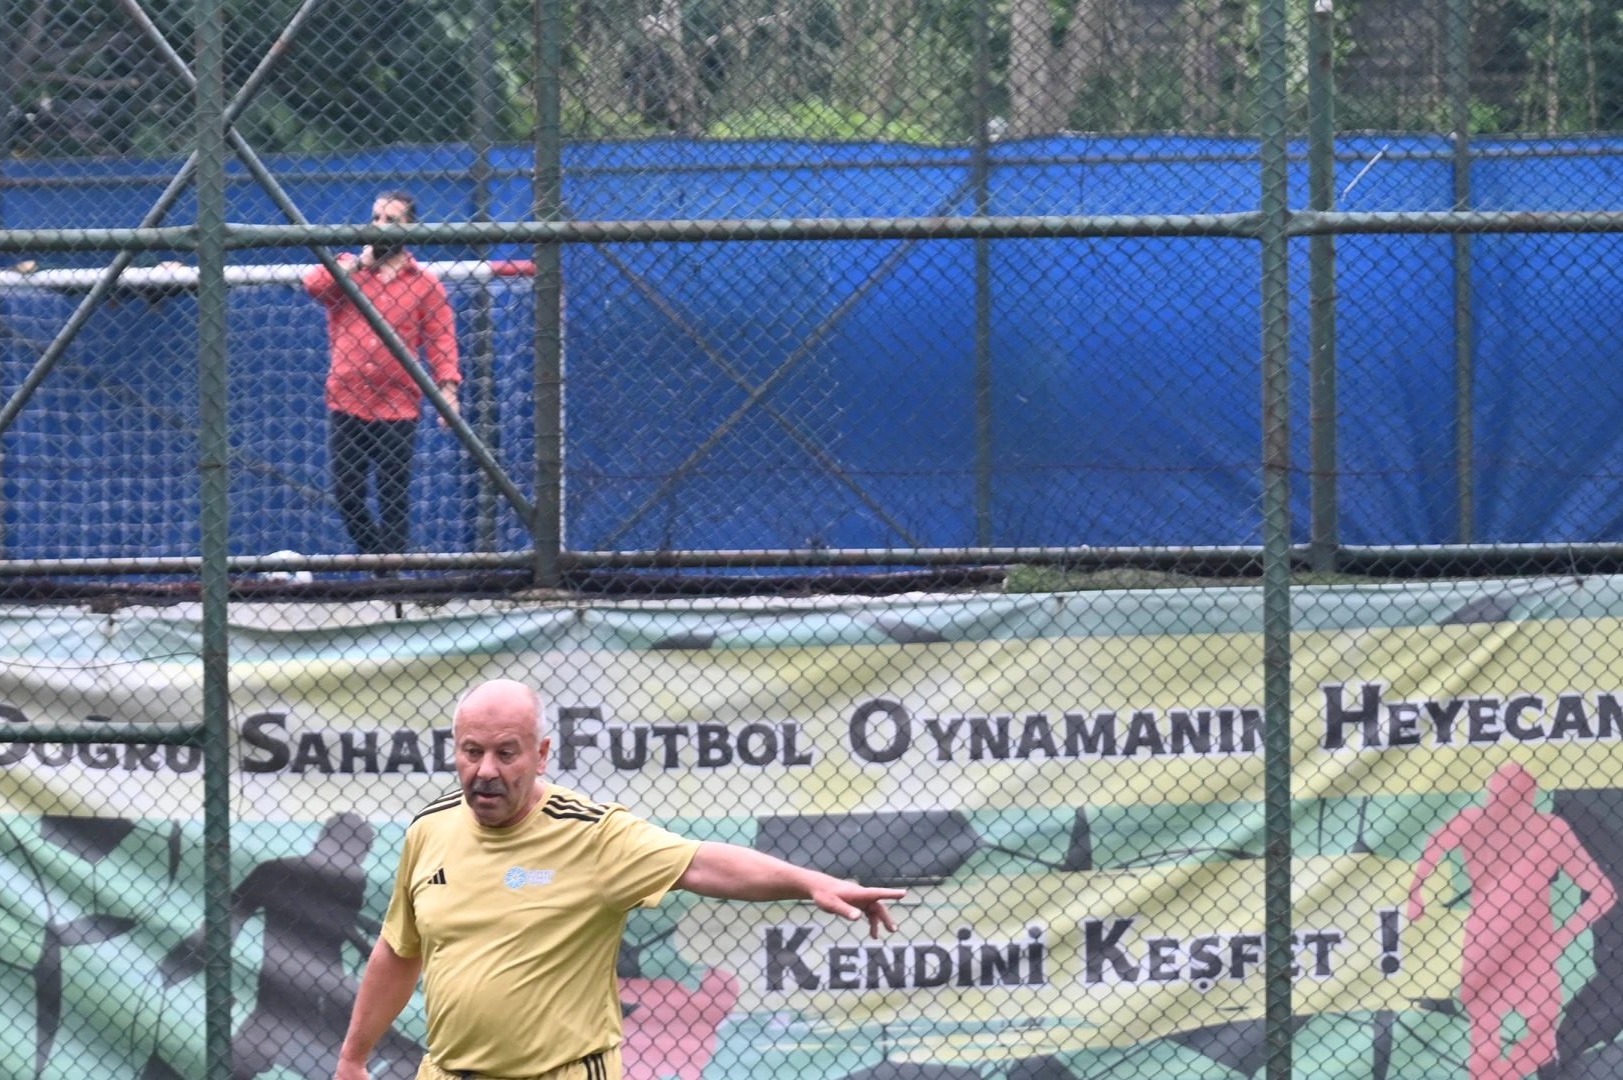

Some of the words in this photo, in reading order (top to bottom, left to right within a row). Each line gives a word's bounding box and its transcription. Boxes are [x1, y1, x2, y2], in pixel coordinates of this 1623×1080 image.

[242, 712, 456, 773] SAHAD
[557, 706, 812, 770] FUTBOL
[765, 927, 1046, 990] KENDİNİ
[1380, 911, 1400, 975] !
